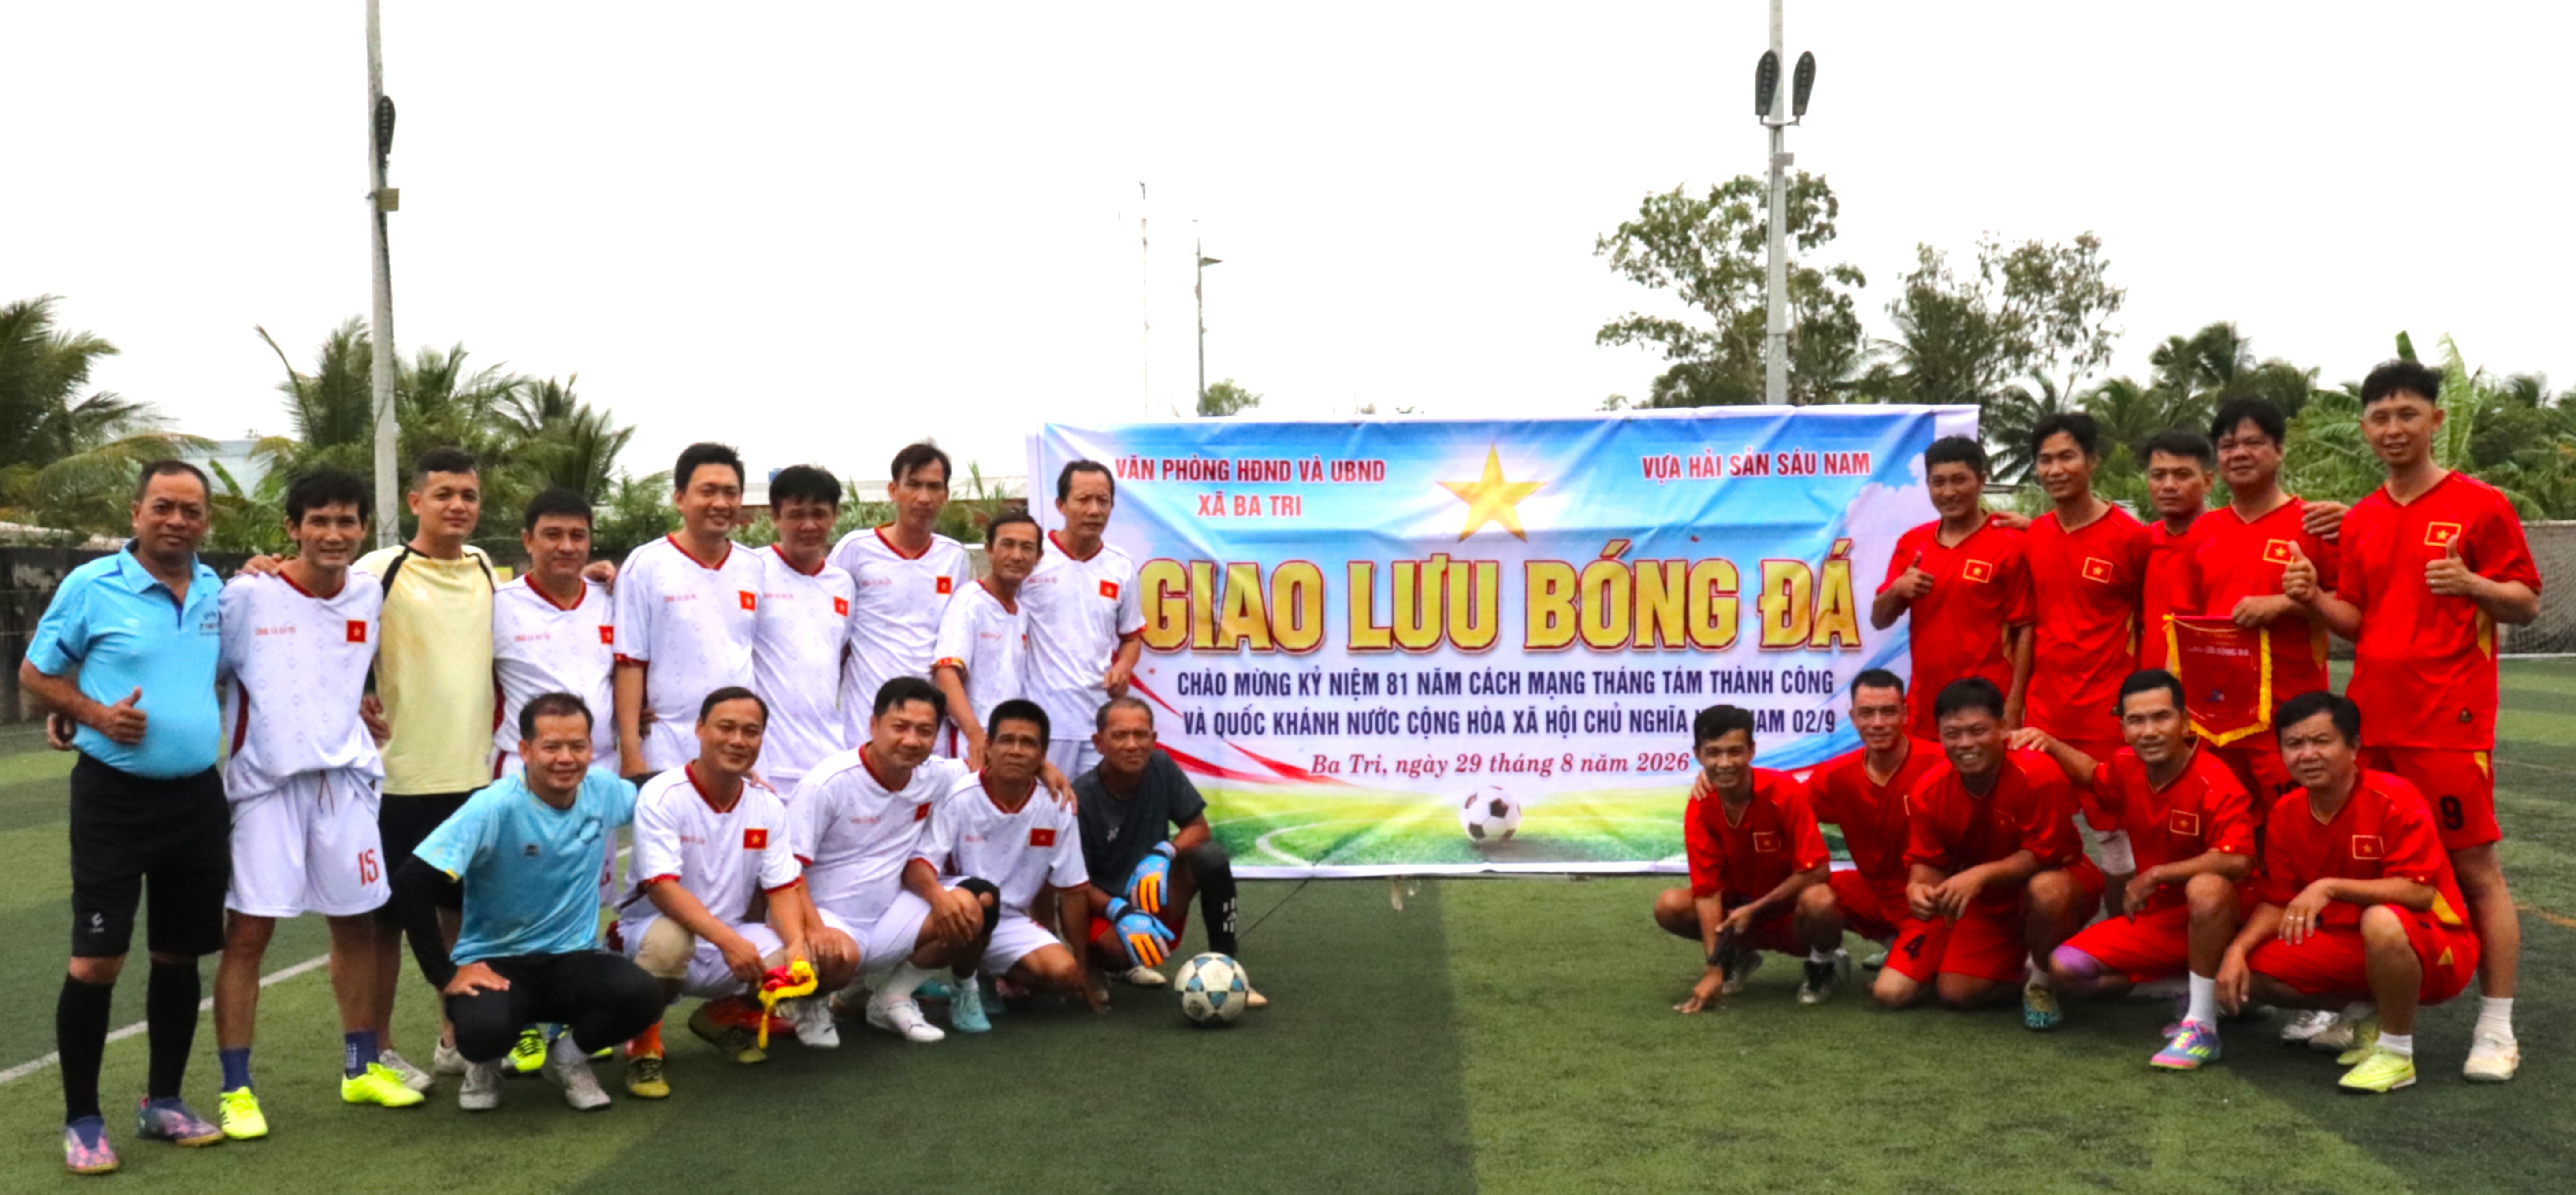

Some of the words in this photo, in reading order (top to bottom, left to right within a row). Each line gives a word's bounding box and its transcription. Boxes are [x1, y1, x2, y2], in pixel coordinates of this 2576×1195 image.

[1115, 454, 1154, 480] VĂN
[1163, 453, 1229, 481] PHÒNG
[1237, 460, 1291, 482] HĐND
[1299, 454, 1324, 482] VÀ
[1331, 460, 1385, 482] UBND
[1643, 455, 1681, 483] VỰA
[1689, 448, 1721, 478] HẢI
[1729, 447, 1769, 476] SẢN
[1777, 450, 1816, 475] SÁU
[1825, 453, 1870, 475] NAM
[1197, 491, 1227, 517] XÃ
[1234, 495, 1262, 517] BA
[1269, 495, 1301, 517] TRI
[1138, 558, 1326, 654] GIAO
[1347, 553, 1499, 651] LƯU
[1523, 538, 1740, 651] BÓNG
[1758, 538, 1862, 649] ĐÁ
[1178, 667, 1226, 696] CHÀO
[1235, 669, 1290, 696] MỪNG
[1299, 666, 1321, 695] KỶ
[1330, 668, 1379, 700] NIỆM
[1387, 673, 1407, 695] 81
[1418, 668, 1461, 695] NĂM
[1470, 667, 1520, 695] CÁCH
[1528, 671, 1585, 699] MẠNG
[1593, 666, 1654, 694] THÁNG
[1662, 666, 1702, 694] TÁM
[1710, 666, 1773, 693] THÀNH
[1782, 665, 1833, 694] CÔNG
[1184, 707, 1206, 735] VÀ
[1214, 704, 1264, 738] QUỐC
[1274, 707, 1338, 735] KHÁNH
[1347, 707, 1399, 734] NƯỚC
[1408, 707, 1459, 739] CỘNG
[1468, 706, 1505, 734] HÒA
[1513, 706, 1538, 733] XÃ
[1546, 705, 1576, 738] HỘI
[1584, 702, 1621, 733] CHỦ
[1630, 705, 1688, 733] NGHĨA
[1793, 709, 1835, 733] 02/9
[1310, 754, 1340, 774] Ba
[1350, 754, 1387, 776] Tri,
[1396, 754, 1448, 778] ngày
[1455, 754, 1482, 773] 29
[1490, 753, 1554, 776] tháng
[1561, 753, 1574, 772] 8
[1580, 755, 1628, 772] năm
[1636, 753, 1690, 771] 2026
[2439, 795, 2463, 830] 9
[358, 849, 379, 886] 15
[1903, 934, 1925, 960] 4
